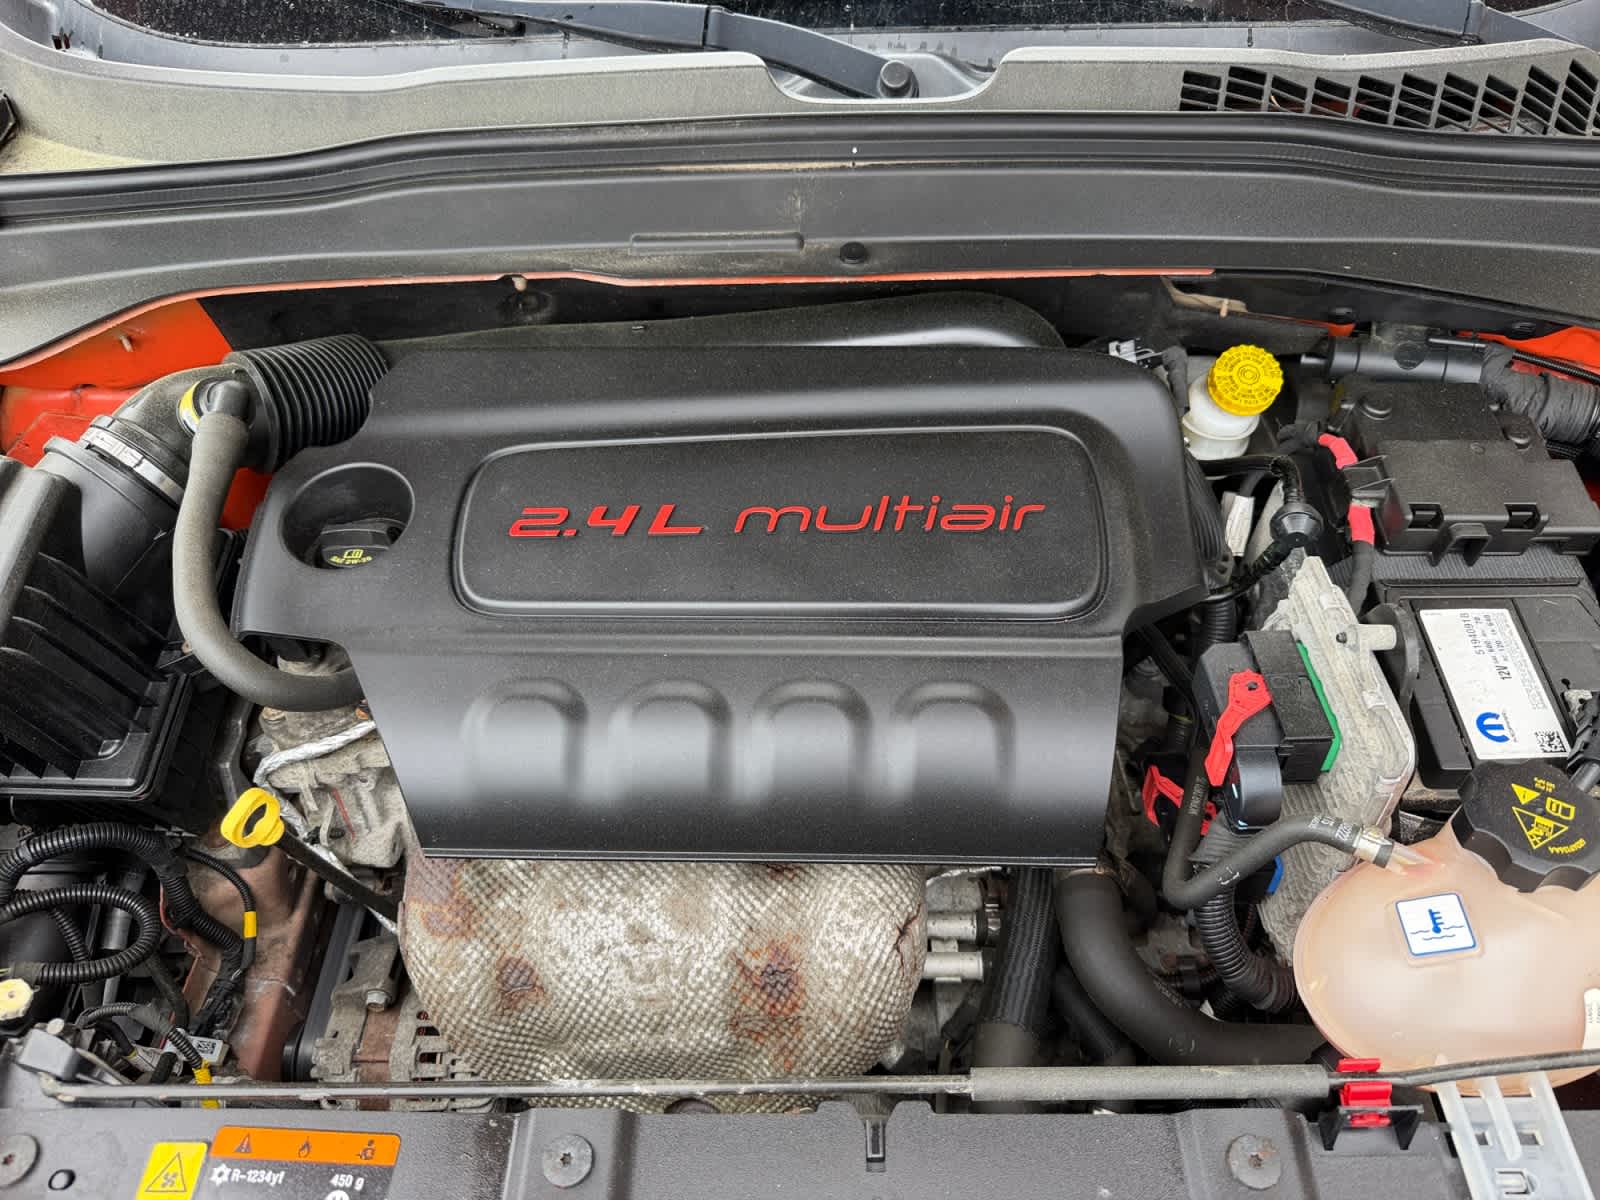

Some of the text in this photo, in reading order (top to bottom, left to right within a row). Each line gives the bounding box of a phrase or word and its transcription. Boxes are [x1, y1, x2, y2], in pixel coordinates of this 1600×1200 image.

[734, 496, 1045, 532] multiair
[1495, 665, 1513, 680] 12V
[231, 1169, 284, 1187] R-1234yf
[330, 1174, 365, 1191] 450 g
